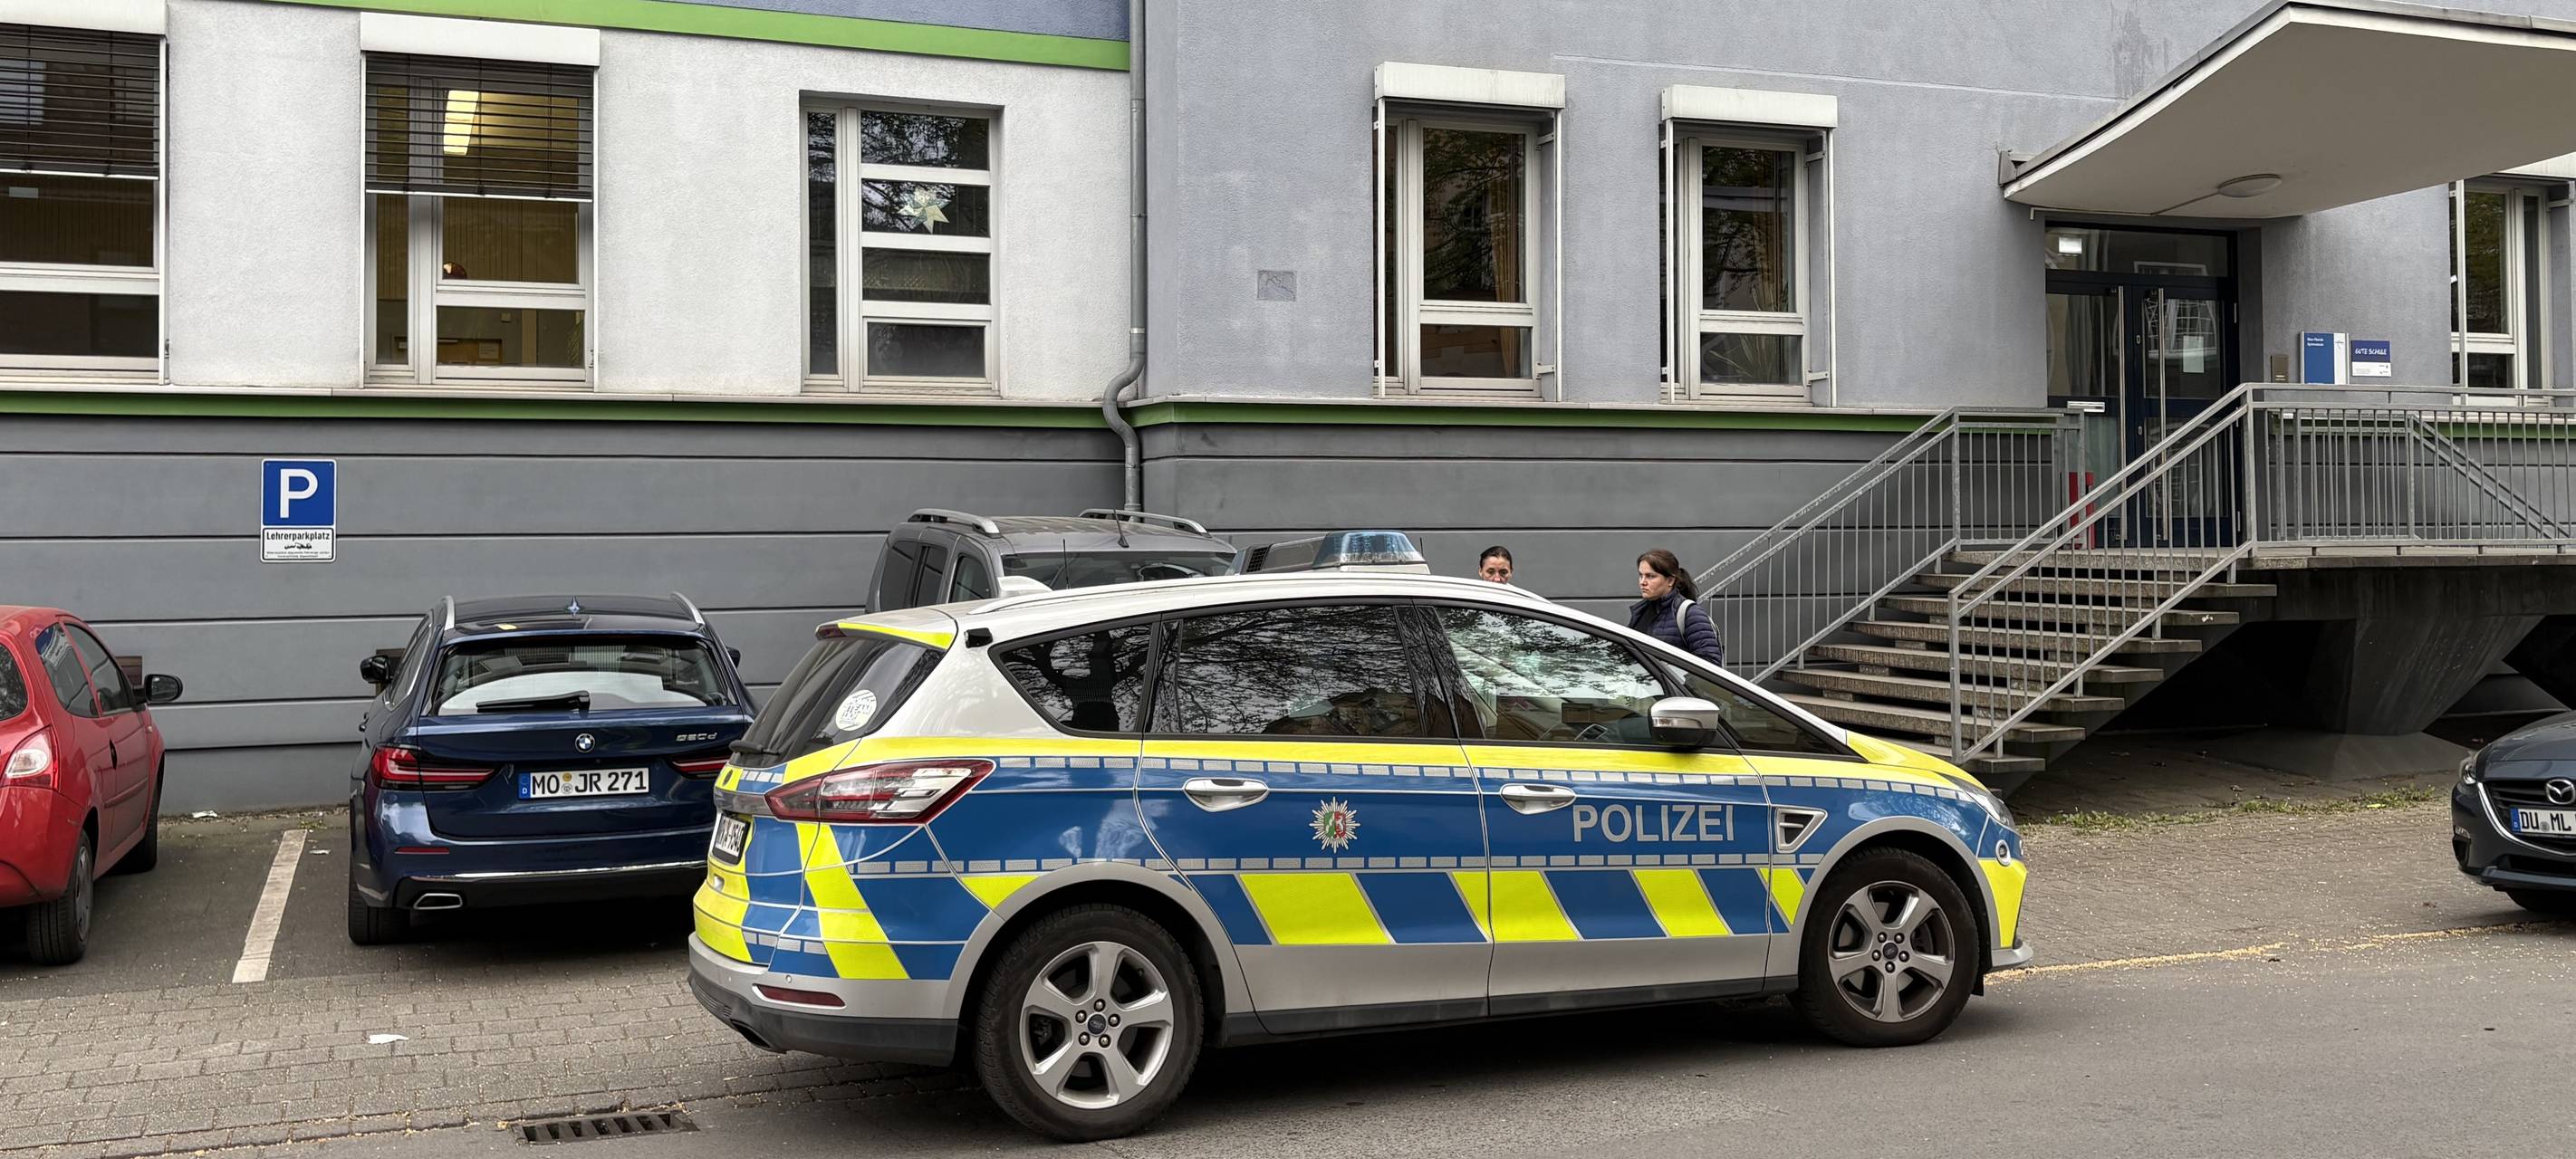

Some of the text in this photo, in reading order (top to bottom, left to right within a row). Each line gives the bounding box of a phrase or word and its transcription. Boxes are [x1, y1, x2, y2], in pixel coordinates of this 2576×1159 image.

[280, 468, 318, 518] P
[266, 532, 330, 541] Lehrerparkplatz
[532, 774, 560, 795] MO
[574, 773, 601, 793] JR
[607, 771, 647, 791] 271
[1572, 804, 1735, 842] POLIZEI
[2520, 811, 2540, 829] DU
[2550, 812, 2571, 831] ML
